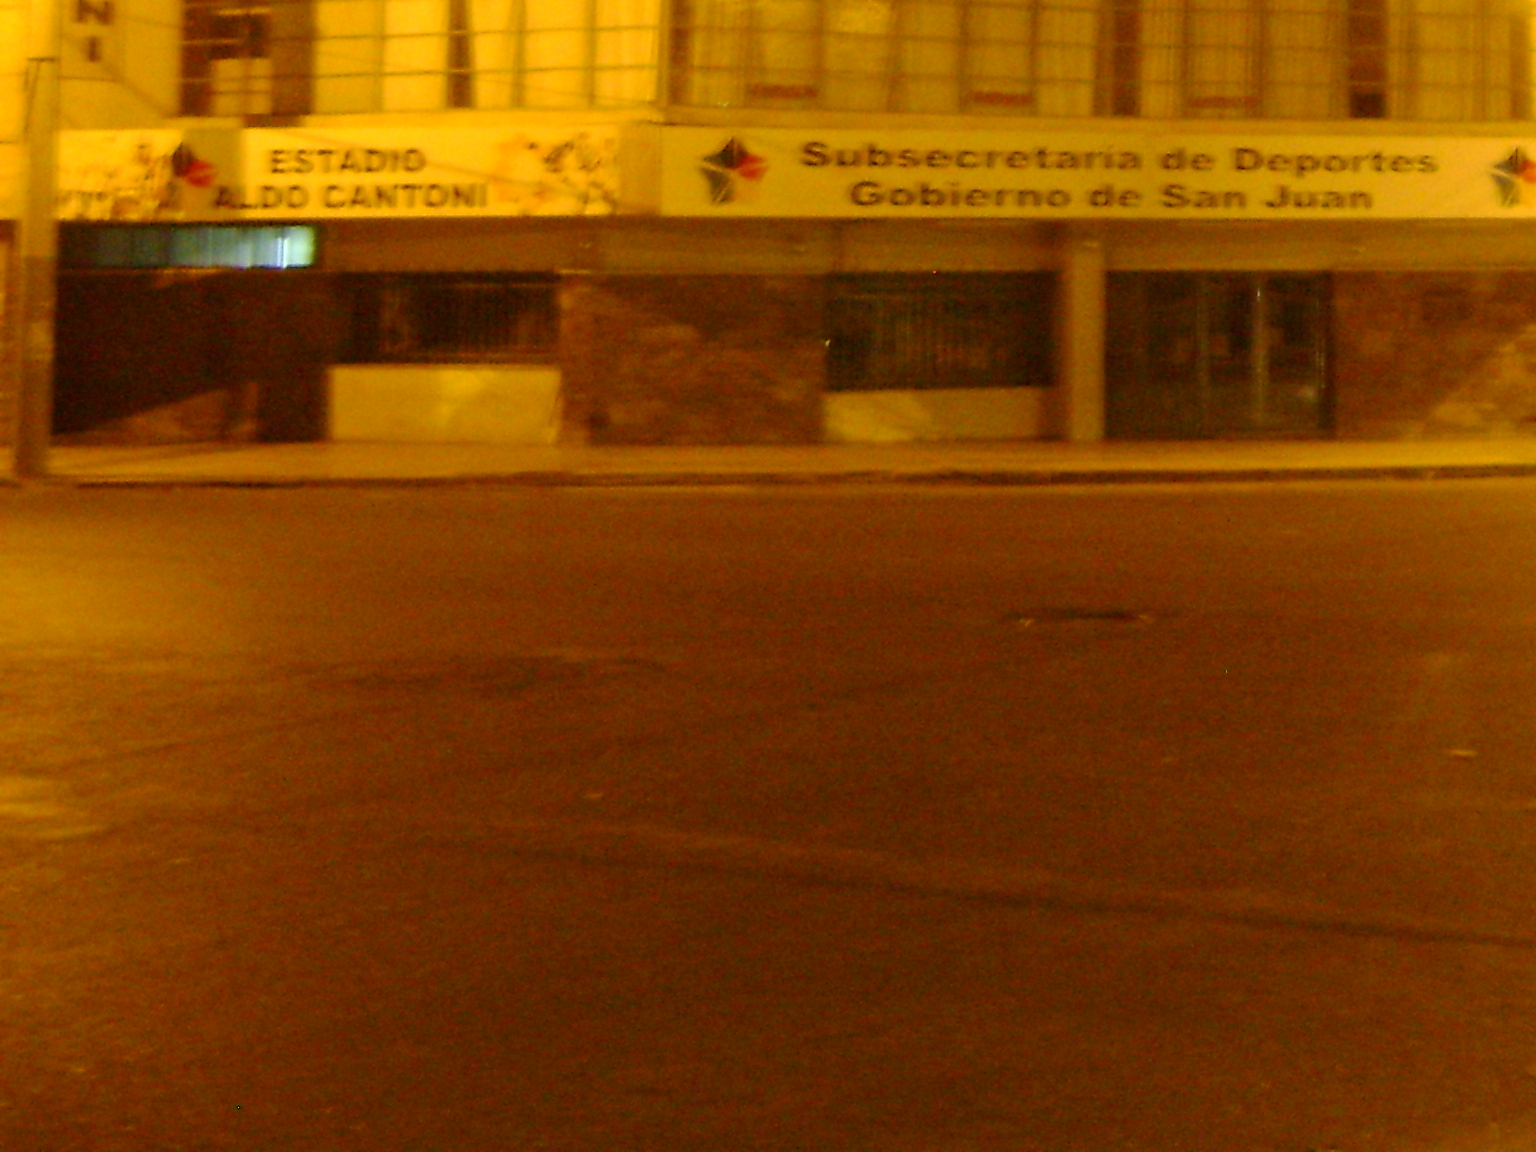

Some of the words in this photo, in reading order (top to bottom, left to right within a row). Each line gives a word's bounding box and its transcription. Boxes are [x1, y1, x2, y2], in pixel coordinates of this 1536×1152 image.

[270, 148, 427, 174] ESTADIO
[1162, 147, 1214, 171] de
[1235, 148, 1438, 178] Deportes
[213, 185, 310, 210] ALDO
[323, 183, 487, 209] CANTONI
[851, 180, 1070, 207] Gobierno
[1089, 183, 1140, 208] de
[1163, 183, 1247, 208] San
[1266, 184, 1373, 209] Juan
